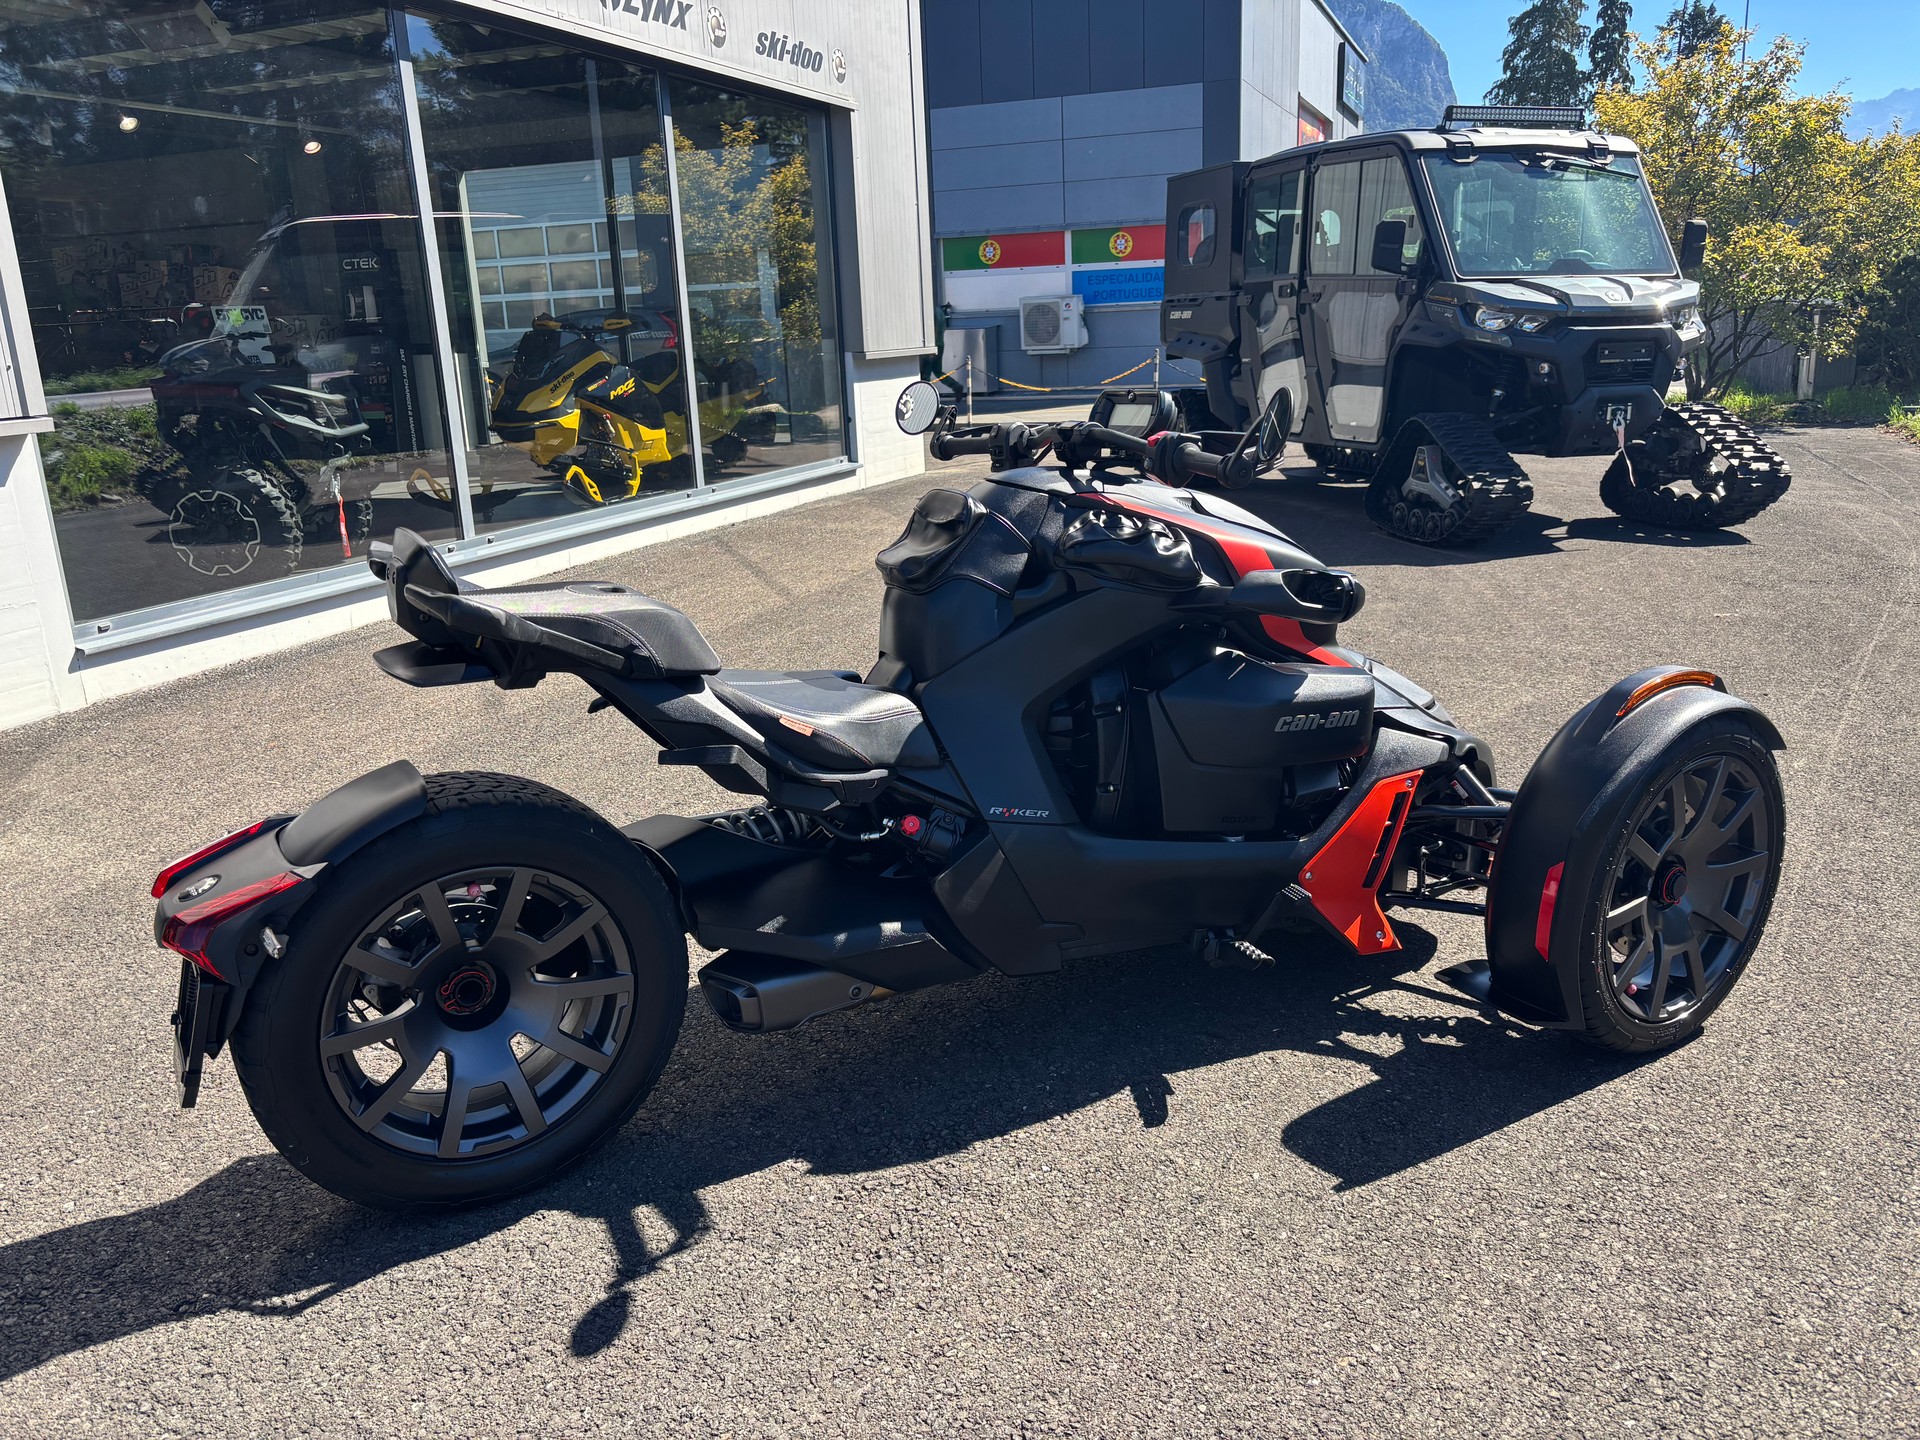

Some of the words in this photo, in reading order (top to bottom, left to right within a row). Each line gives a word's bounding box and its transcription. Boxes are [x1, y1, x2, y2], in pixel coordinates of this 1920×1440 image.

[756, 31, 824, 73] ski-doo
[343, 257, 379, 269] CTEK
[1169, 310, 1192, 320] can-am
[550, 371, 575, 394] ski-doo
[609, 377, 636, 400] MXZ
[1274, 709, 1360, 733] can-am
[989, 806, 1050, 818] RYKER
